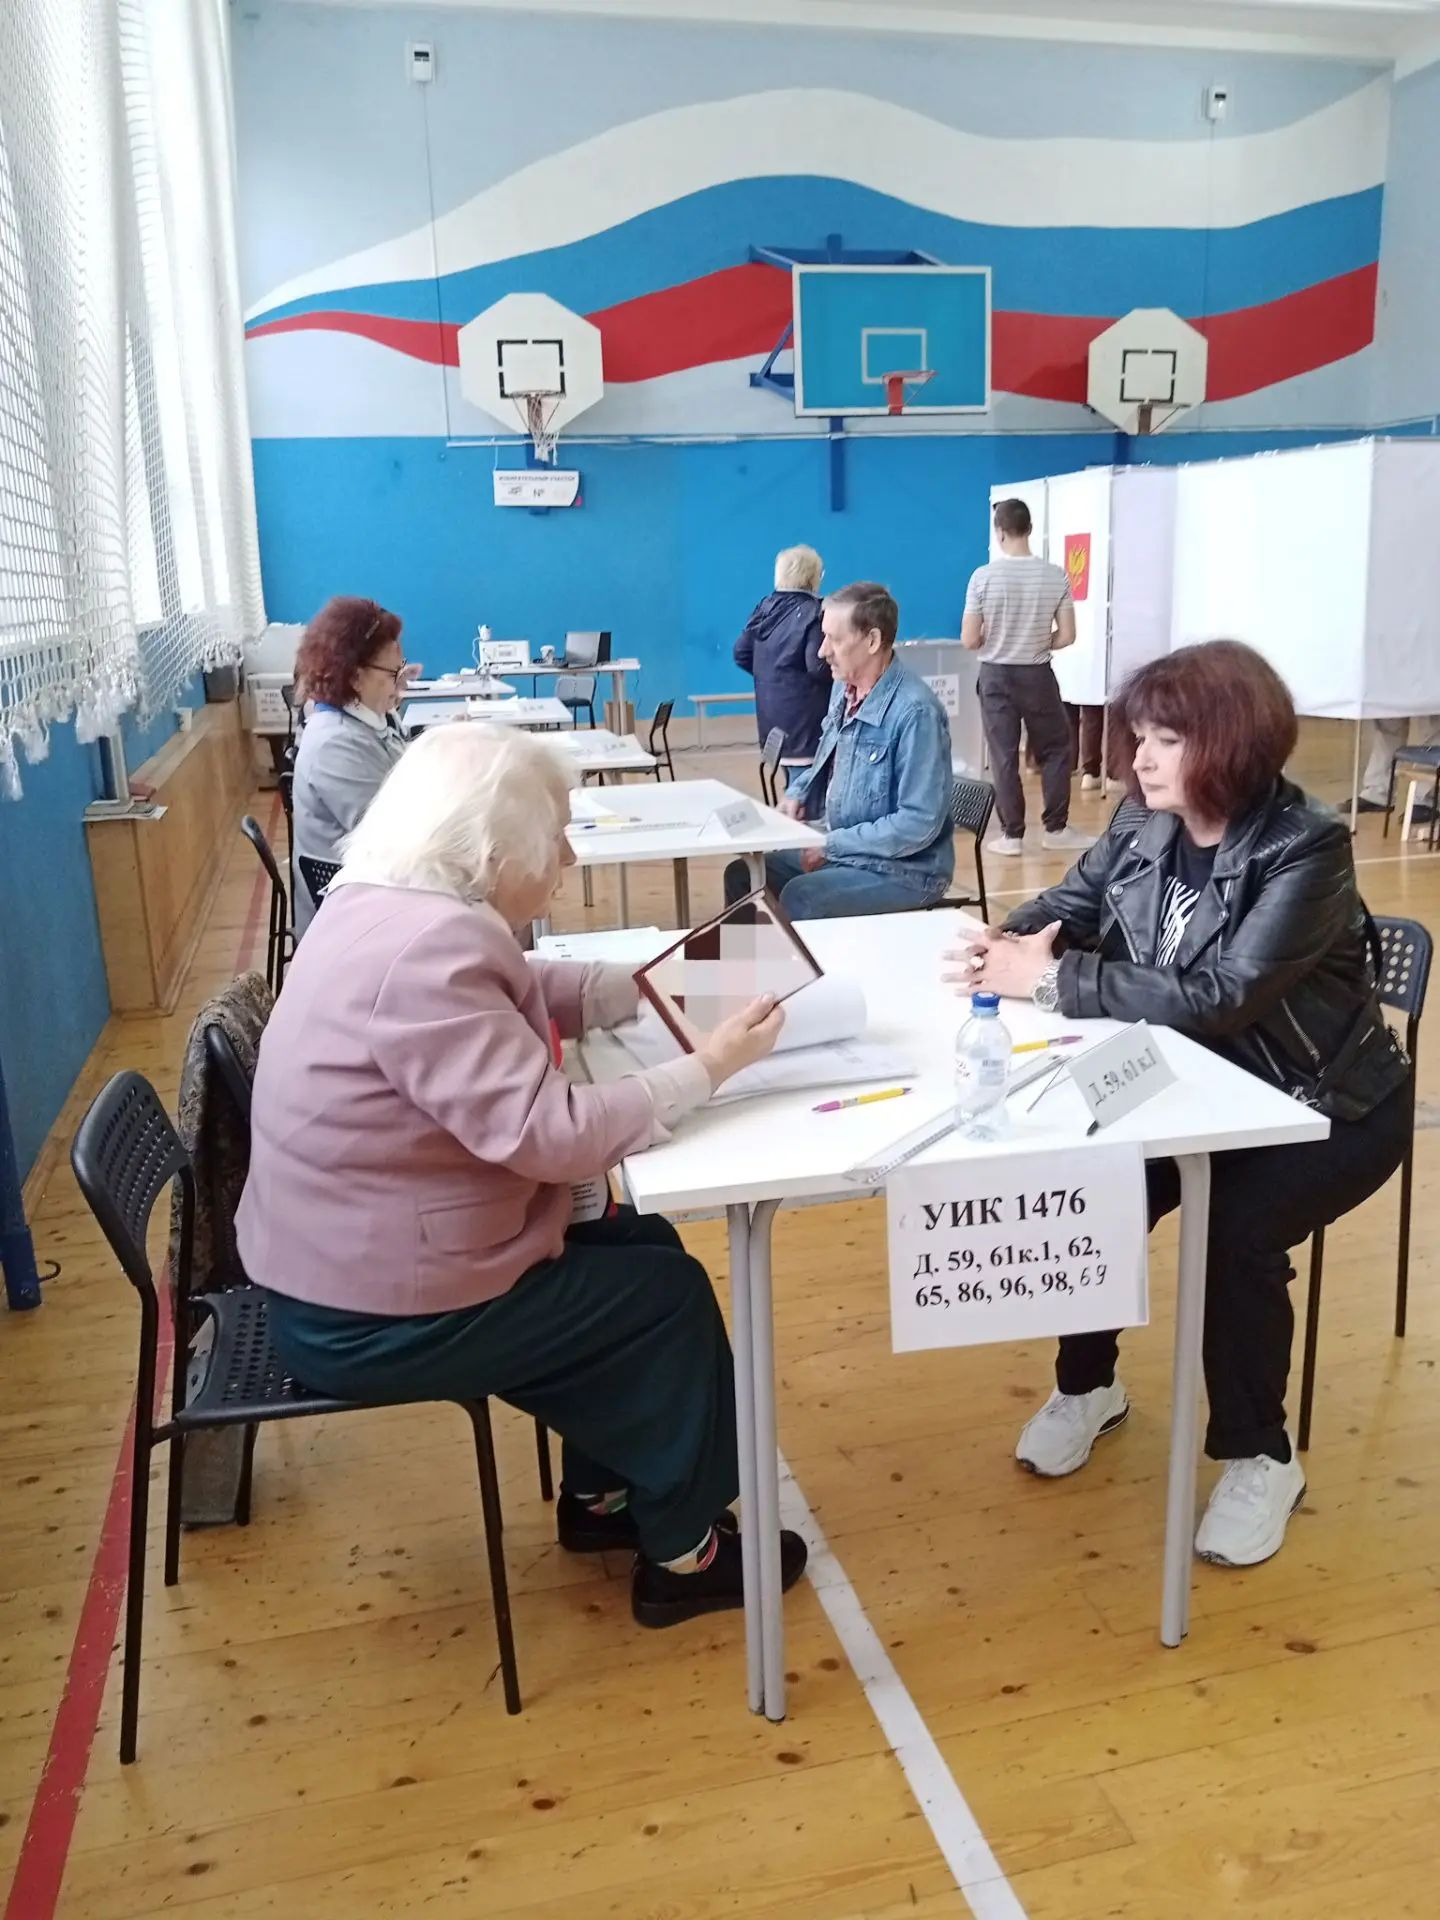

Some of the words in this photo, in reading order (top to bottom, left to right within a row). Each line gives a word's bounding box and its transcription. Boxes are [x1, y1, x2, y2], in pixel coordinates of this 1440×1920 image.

[920, 1197, 1003, 1231] УИК
[1015, 1187, 1086, 1221] 1476
[913, 1253, 940, 1280] Д.
[947, 1249, 983, 1272] 59,
[990, 1241, 1061, 1267] 61к.1,
[1068, 1236, 1102, 1259] 62,
[915, 1285, 951, 1309] 65,
[958, 1280, 993, 1304] 86,
[1000, 1275, 1034, 1300] 96,
[1041, 1271, 1075, 1296] 98,
